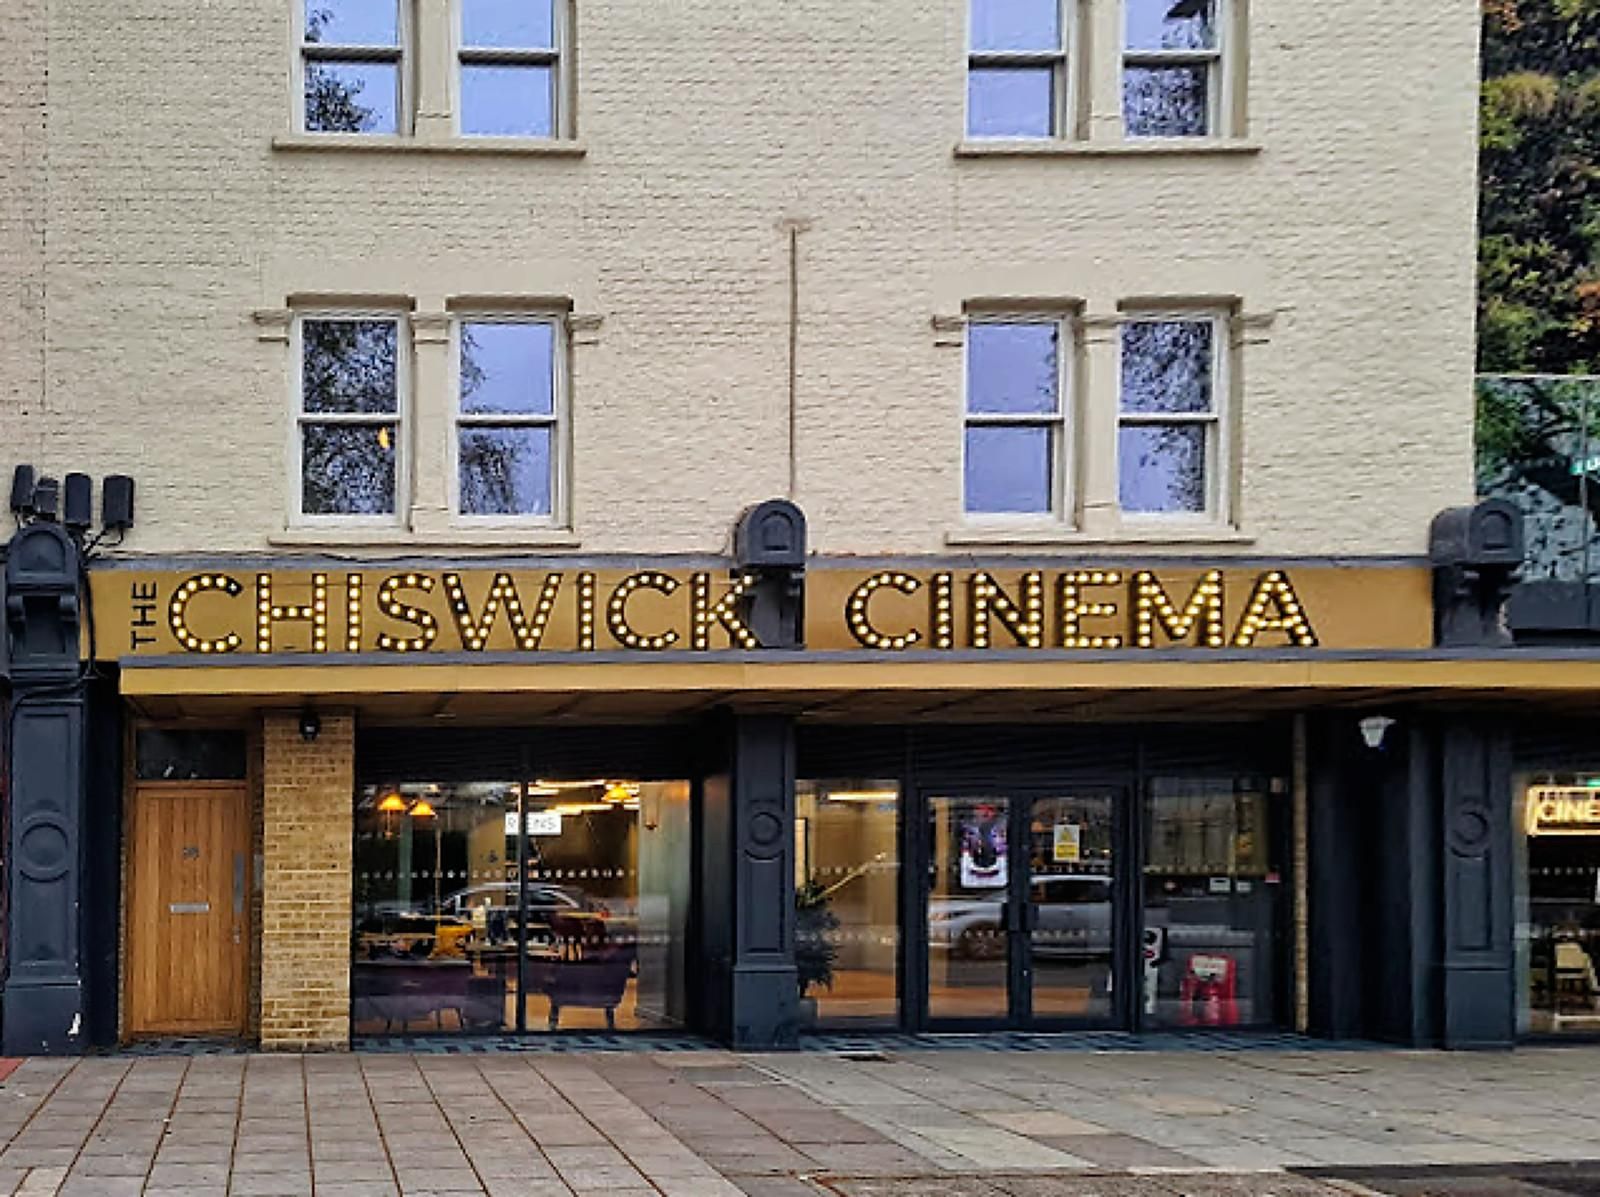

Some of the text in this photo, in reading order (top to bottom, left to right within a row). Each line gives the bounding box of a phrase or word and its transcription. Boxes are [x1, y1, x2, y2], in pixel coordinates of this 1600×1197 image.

[131, 570, 1319, 652] THE CHISWICK CINEMA
